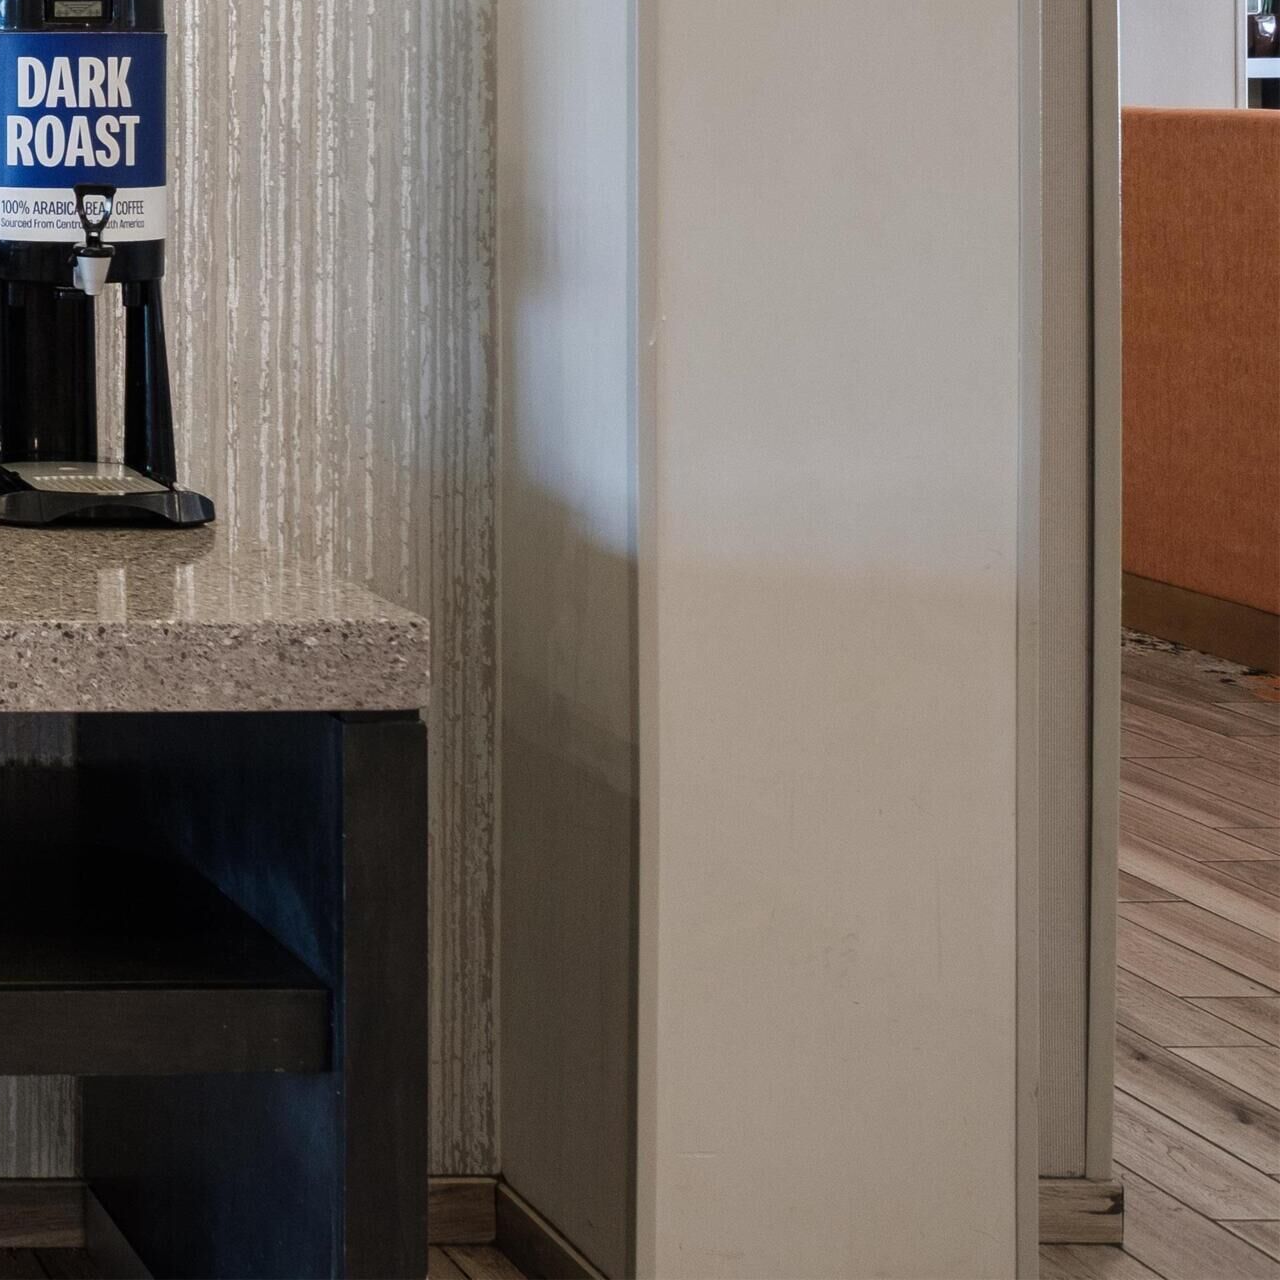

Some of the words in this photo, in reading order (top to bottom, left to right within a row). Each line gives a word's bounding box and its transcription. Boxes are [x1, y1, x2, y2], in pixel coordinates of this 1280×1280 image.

[17, 56, 132, 108] DARK
[6, 114, 141, 167] ROAST
[1, 199, 30, 215] 100%
[85, 201, 112, 216] BEA
[116, 200, 144, 216] COFFEE
[1, 217, 32, 229] Sourced
[34, 218, 54, 230] From
